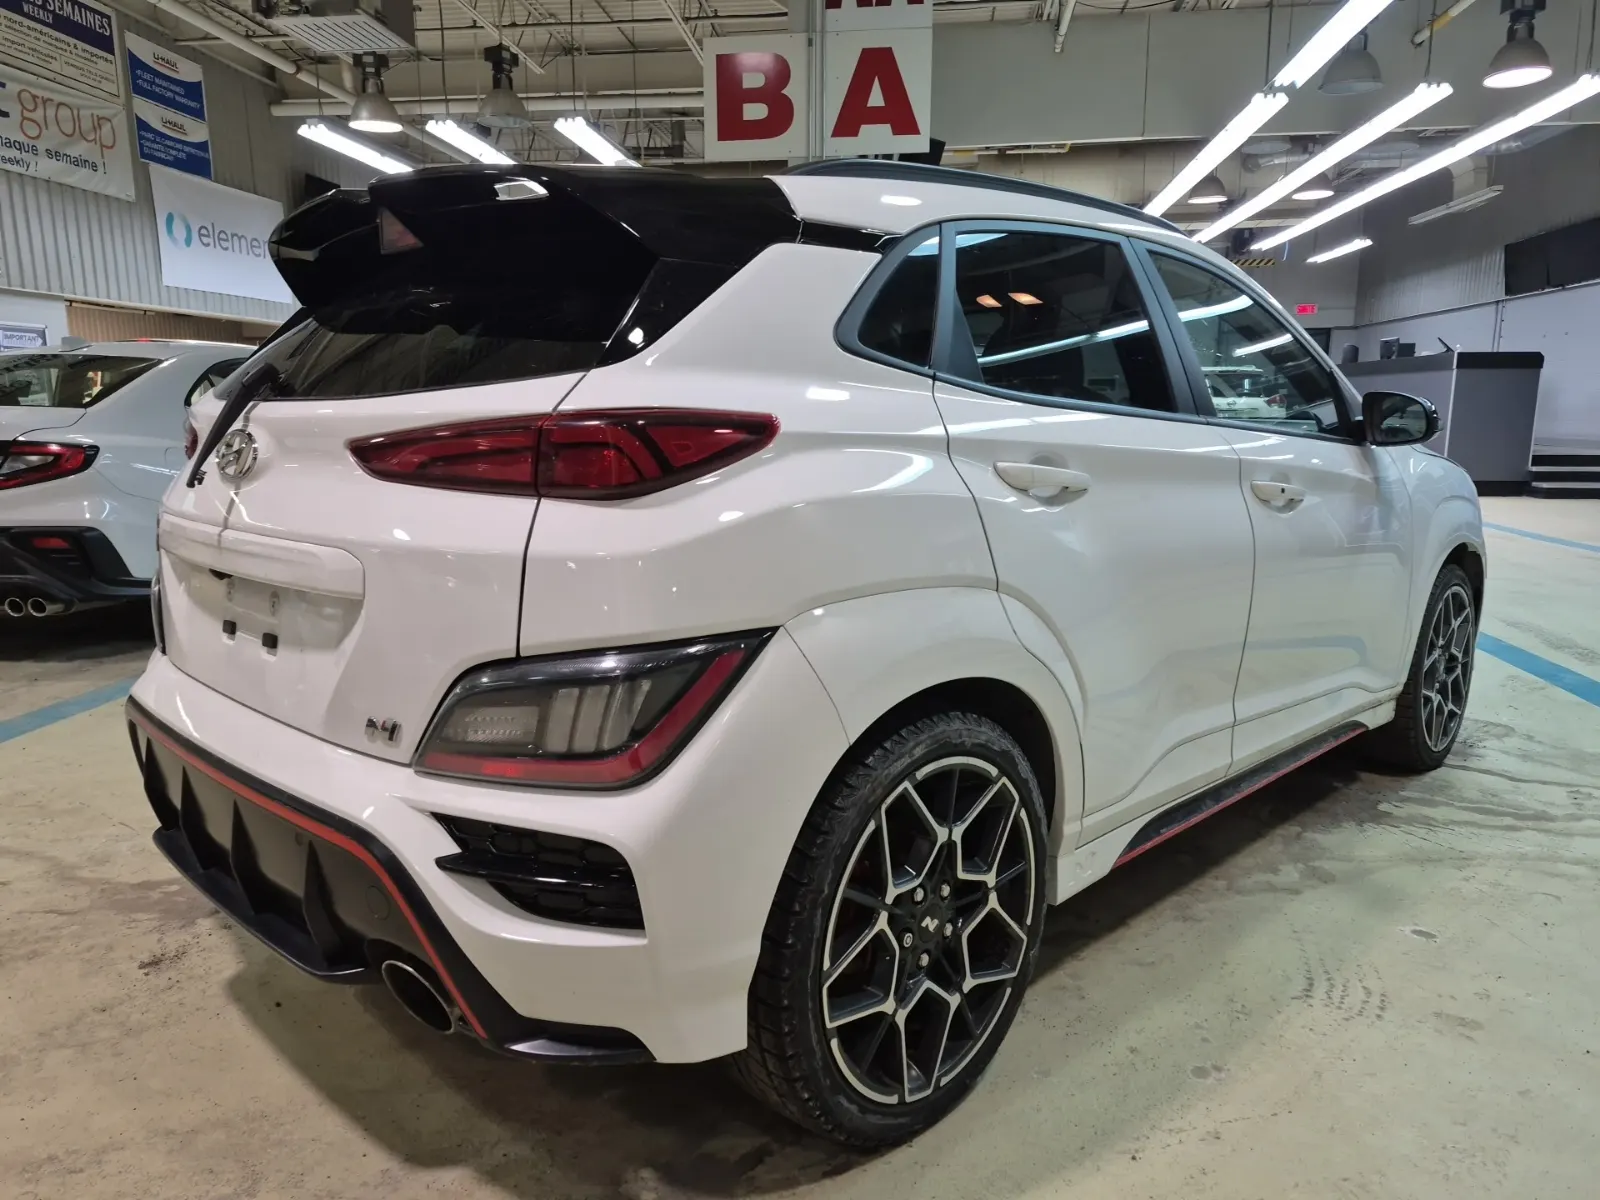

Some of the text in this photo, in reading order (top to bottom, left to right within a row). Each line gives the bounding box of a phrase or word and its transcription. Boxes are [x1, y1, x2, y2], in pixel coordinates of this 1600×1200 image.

[22, 2, 53, 24] WEEKLY
[46, 0, 111, 36] SEMAINES
[153, 52, 179, 69] U-HAUL
[716, 52, 794, 141] B
[831, 47, 921, 138] A
[17, 88, 116, 160] group
[0, 154, 31, 172] eekly
[45, 147, 98, 173] semaine
[4, 333, 39, 342] IMPORTANT
[920, 915, 940, 933] N
